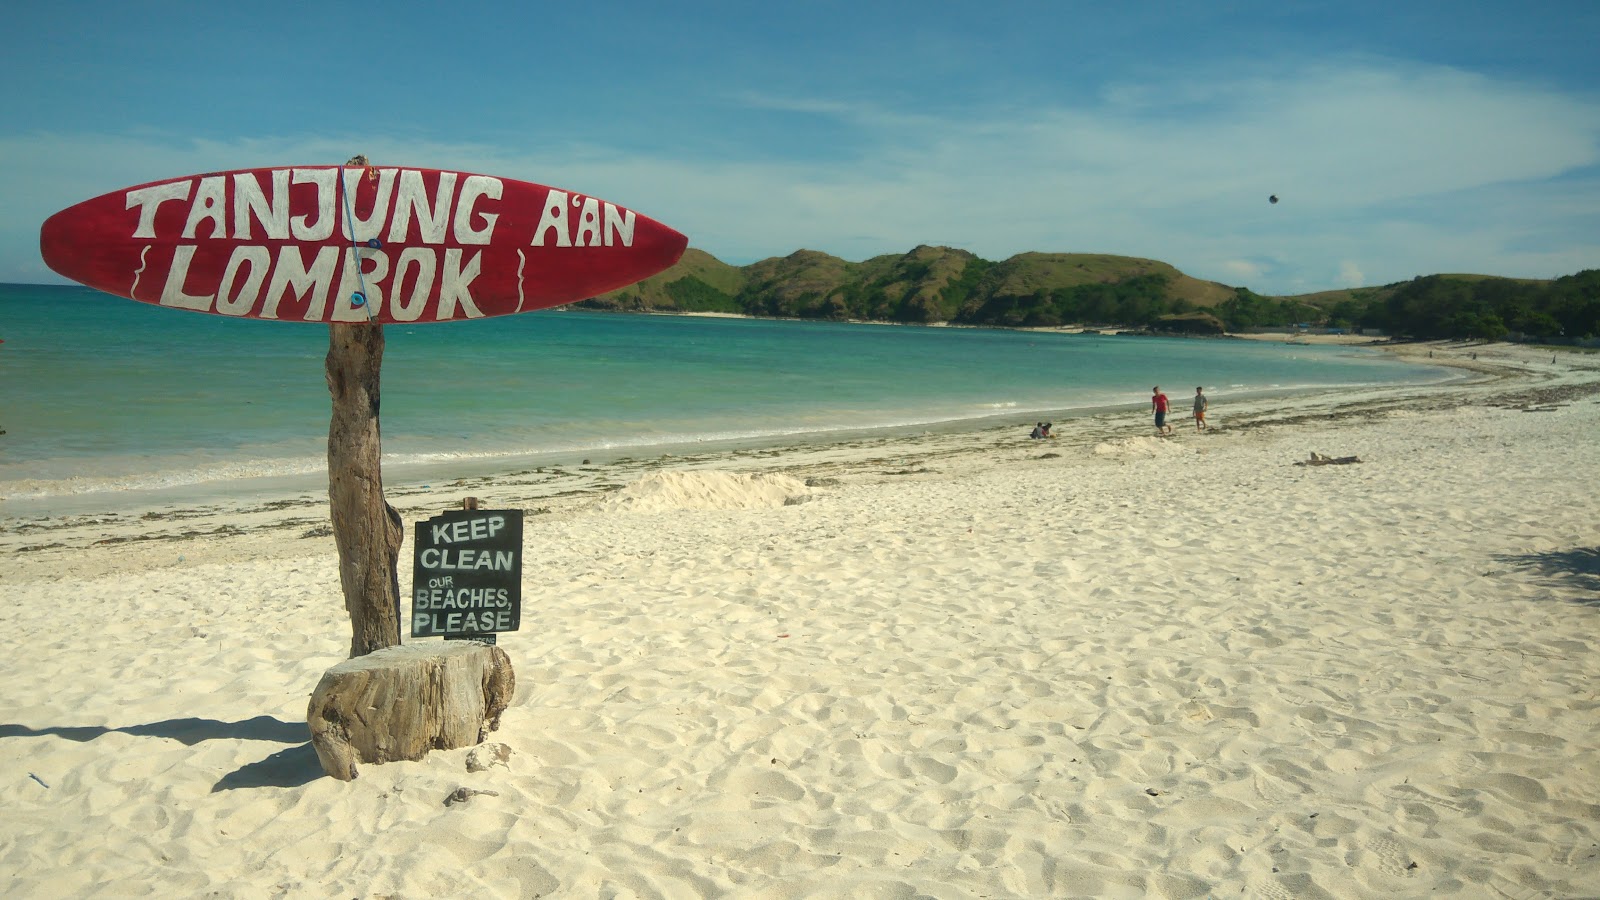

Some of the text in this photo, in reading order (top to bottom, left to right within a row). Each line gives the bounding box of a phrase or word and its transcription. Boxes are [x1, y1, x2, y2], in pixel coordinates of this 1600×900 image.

[125, 168, 503, 245] TANJUNG
[159, 245, 486, 322] LOMBOK
[432, 516, 505, 545] KEEP
[420, 548, 514, 571] CLEAN
[428, 575, 454, 589] OUR
[416, 588, 513, 611] BEACHES,
[413, 611, 512, 634] PLEASE
